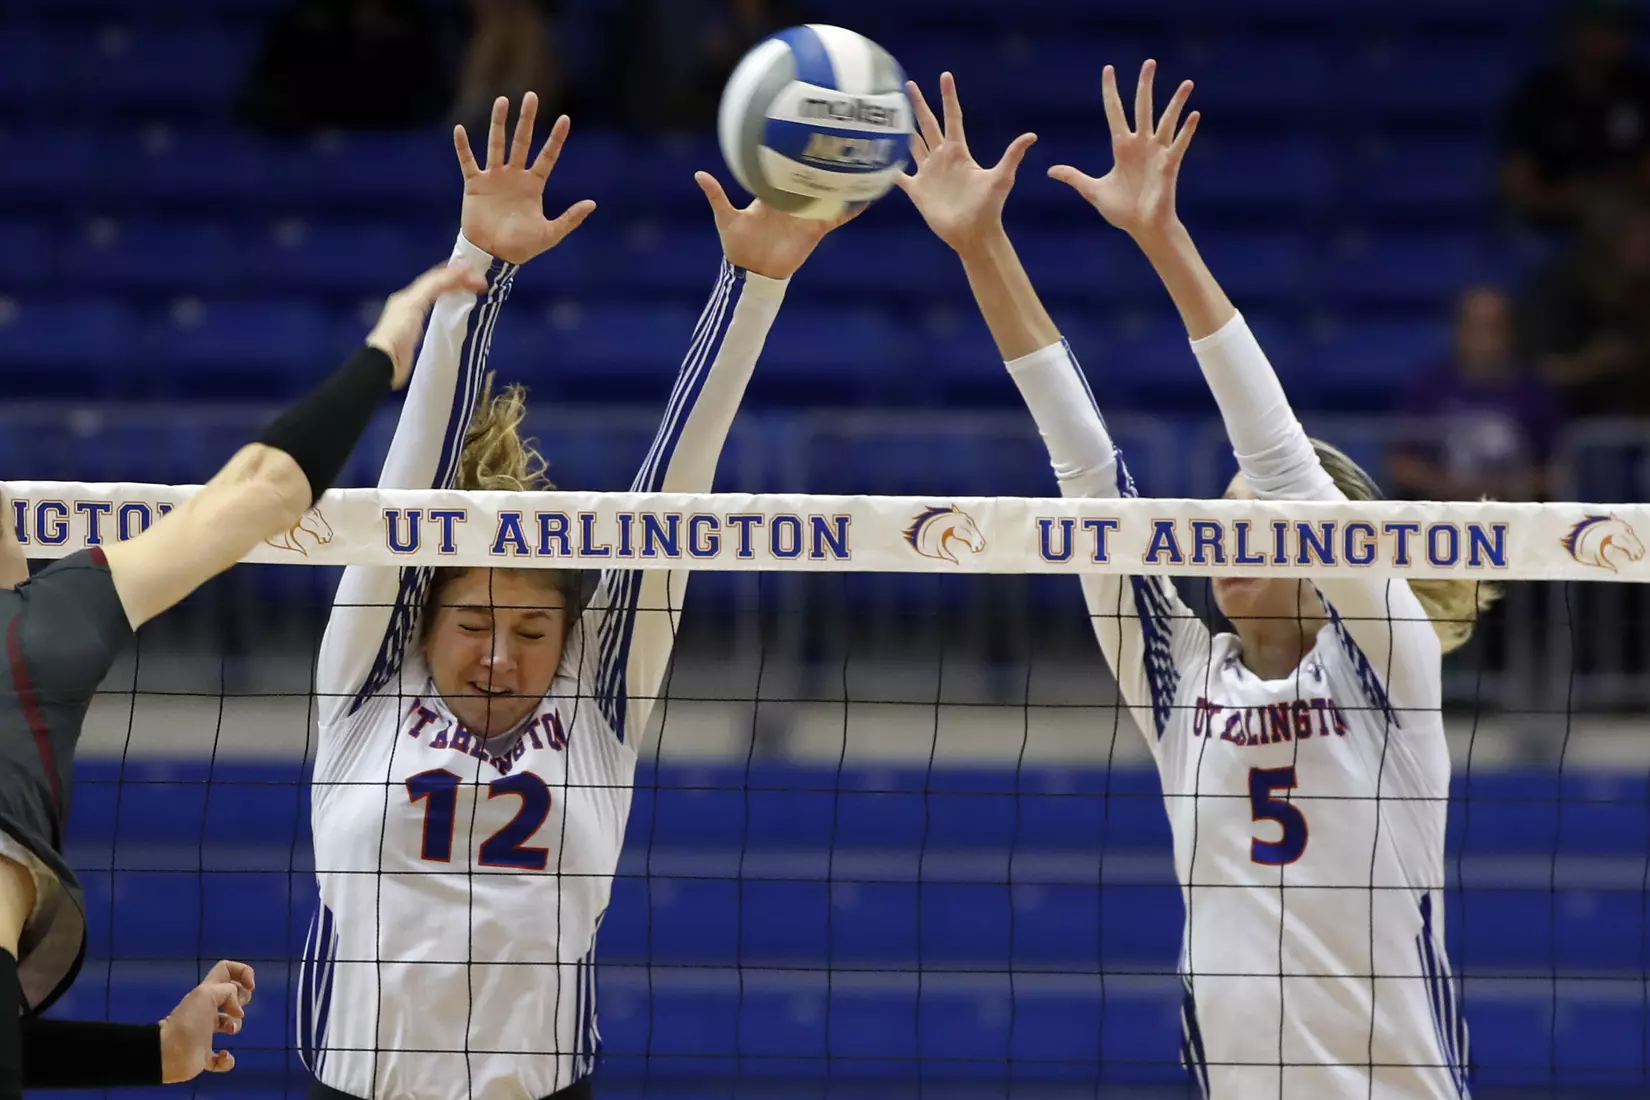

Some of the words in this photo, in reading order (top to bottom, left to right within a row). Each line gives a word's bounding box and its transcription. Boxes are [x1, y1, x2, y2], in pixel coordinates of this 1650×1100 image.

[383, 508, 467, 555] UT
[489, 510, 852, 560] ARLINGTON
[1036, 516, 1121, 564] UT
[1142, 518, 1509, 569] ARLINGTON
[405, 768, 552, 870] 12
[1248, 765, 1309, 866] 5
